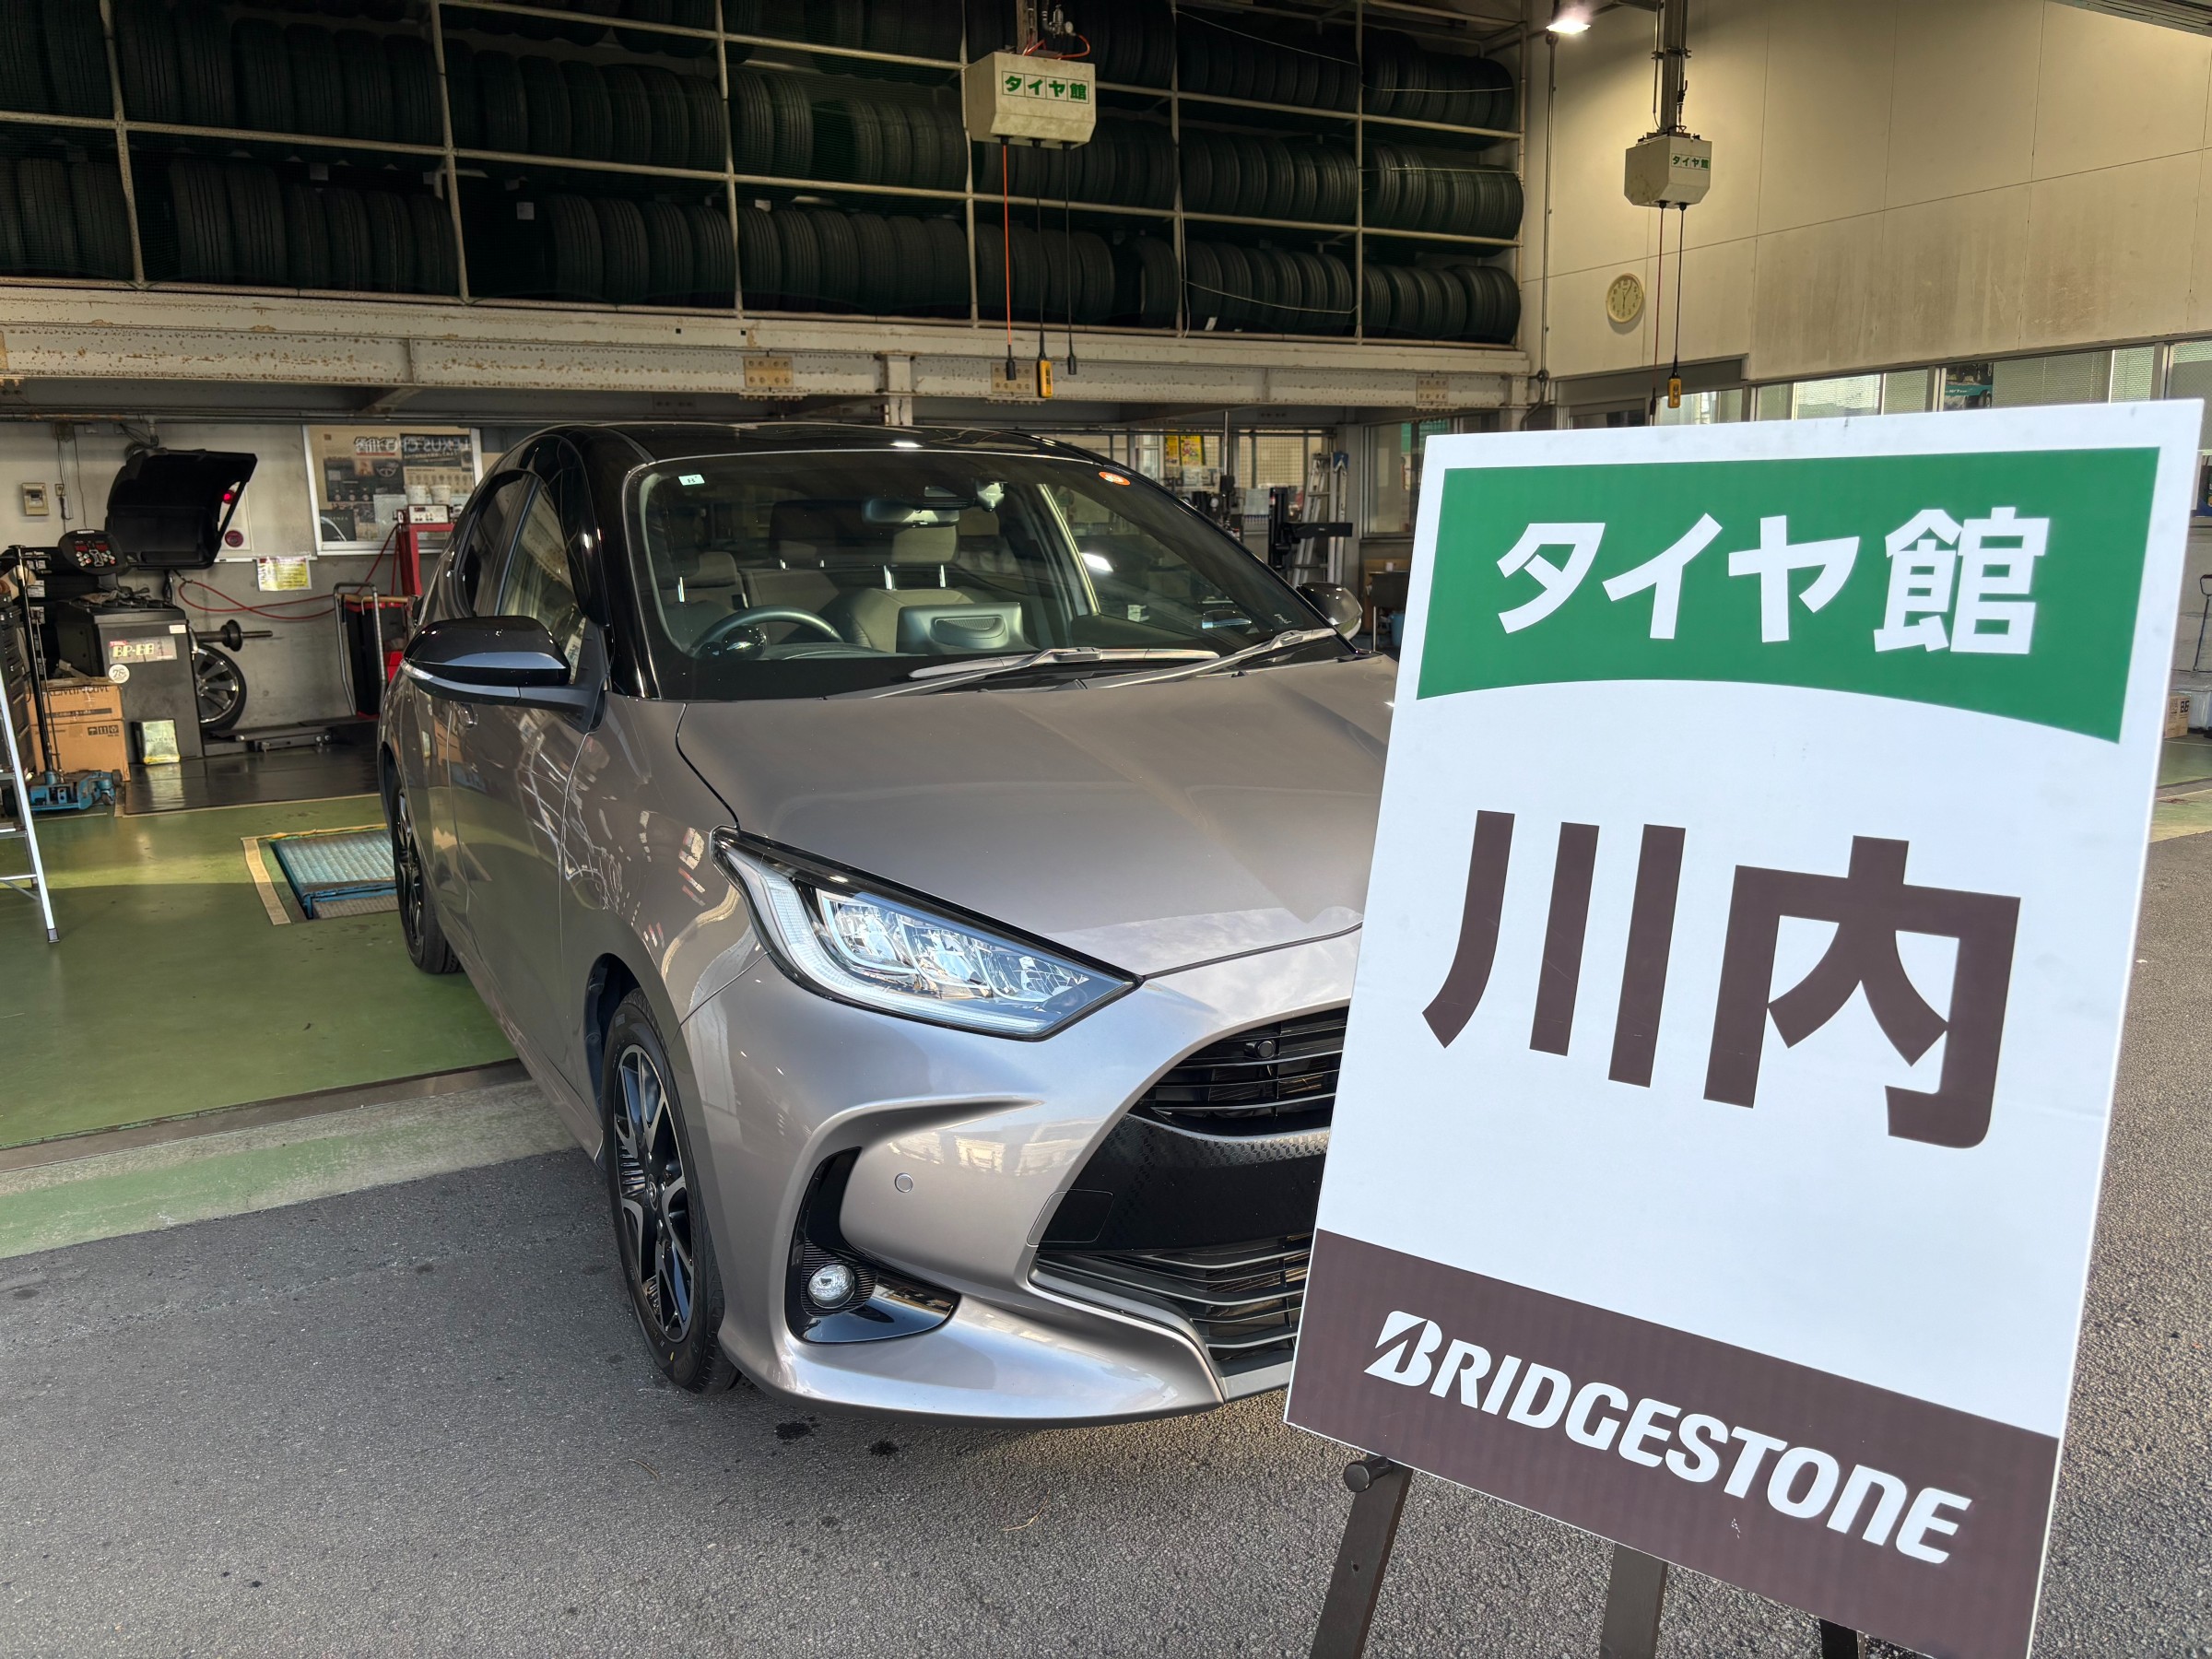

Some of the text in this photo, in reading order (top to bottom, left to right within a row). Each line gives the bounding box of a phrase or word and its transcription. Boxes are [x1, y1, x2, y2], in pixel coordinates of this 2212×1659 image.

[1005, 76, 1087, 100] タイヤ館
[1497, 507, 2050, 654] タイヤ館
[1422, 809, 2021, 1149] 川内
[1364, 1311, 1971, 1564] BRIDGESTONE
